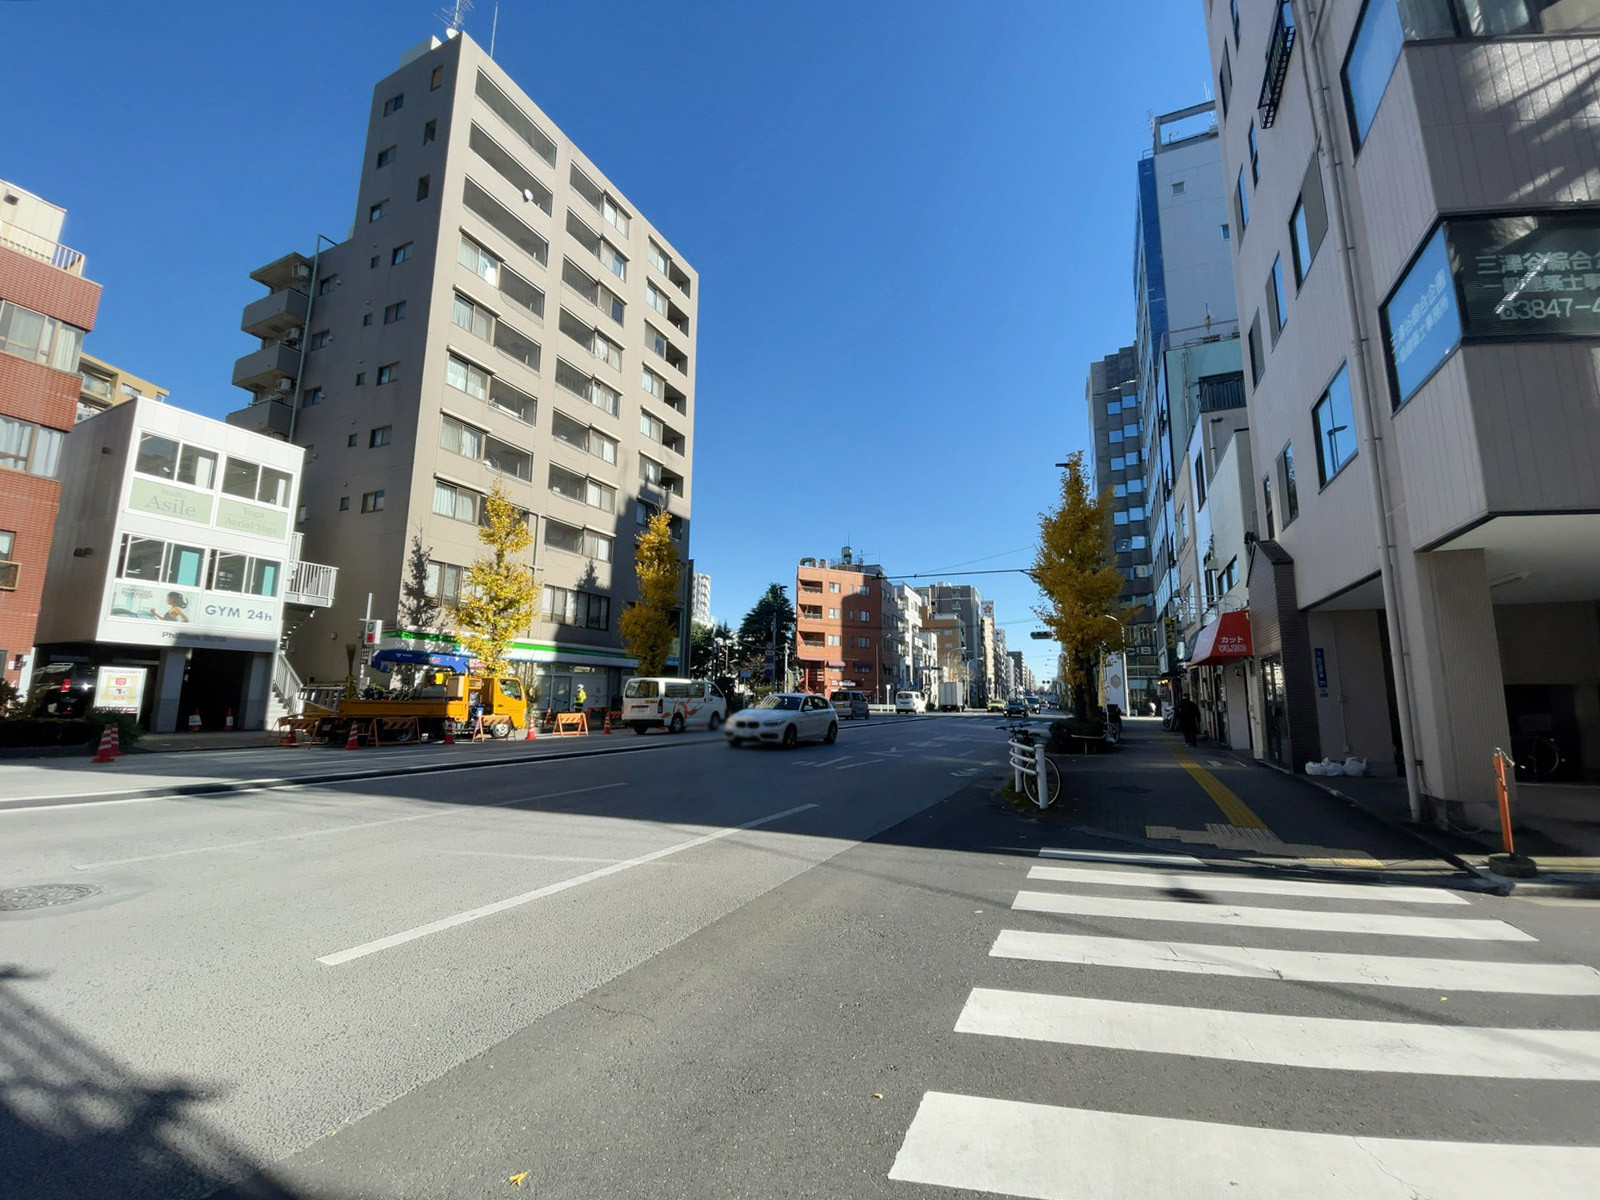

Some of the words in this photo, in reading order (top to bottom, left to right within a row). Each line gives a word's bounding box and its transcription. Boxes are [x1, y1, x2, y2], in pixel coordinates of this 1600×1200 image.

[145, 494, 197, 518] Asile
[243, 506, 265, 520] Yoga
[225, 516, 254, 530] Aerial
[256, 522, 278, 537] Yoga
[205, 604, 241, 619] GYM
[246, 609, 272, 622] 24h
[1221, 636, 1244, 645] カット
